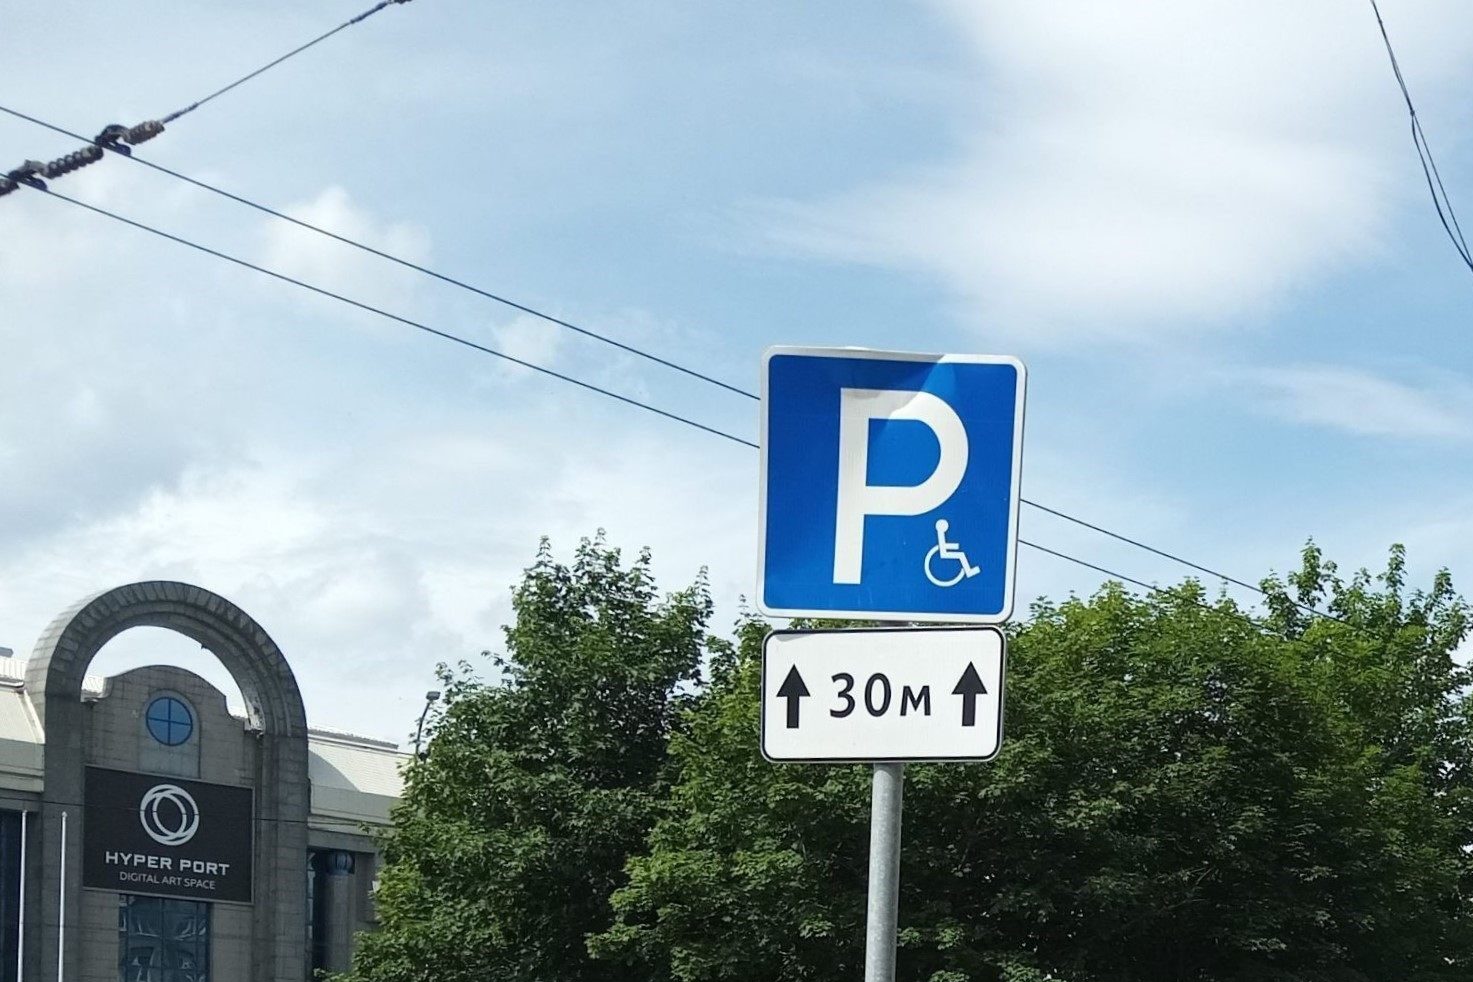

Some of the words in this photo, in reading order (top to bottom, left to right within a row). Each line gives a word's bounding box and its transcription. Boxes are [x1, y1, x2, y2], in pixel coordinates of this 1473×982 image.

[833, 387, 969, 584] P
[105, 851, 172, 870] HYPER
[179, 859, 230, 876] PORT
[119, 871, 159, 884] DIGITAL
[162, 876, 181, 886] ART
[184, 879, 216, 890] SPACE
